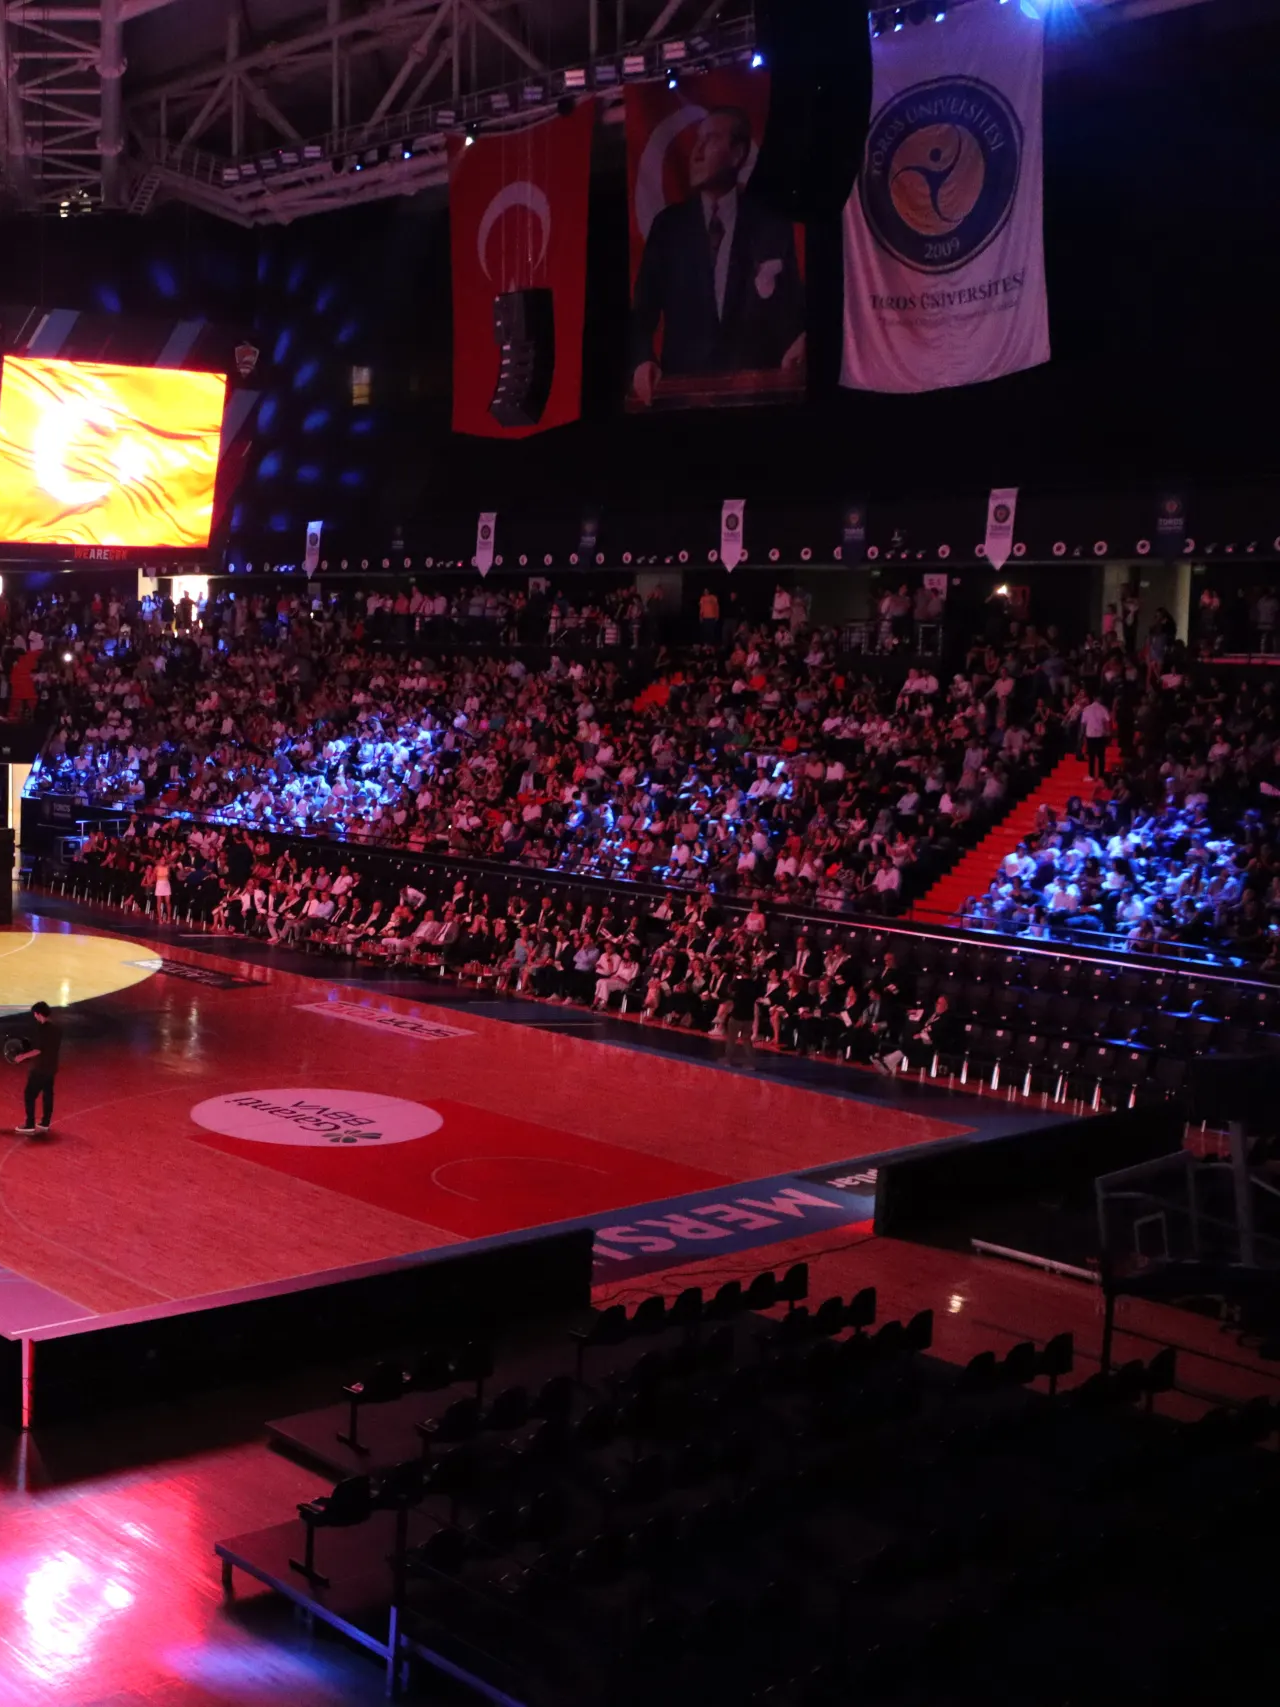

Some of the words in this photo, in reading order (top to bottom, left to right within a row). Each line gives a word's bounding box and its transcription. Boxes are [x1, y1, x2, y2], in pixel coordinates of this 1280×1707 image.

[924, 237, 960, 260] 2009
[870, 294, 917, 310] TOROS
[224, 1097, 341, 1132] Garanti
[291, 1100, 376, 1126] BBVA
[591, 1187, 844, 1266] MERSİ
